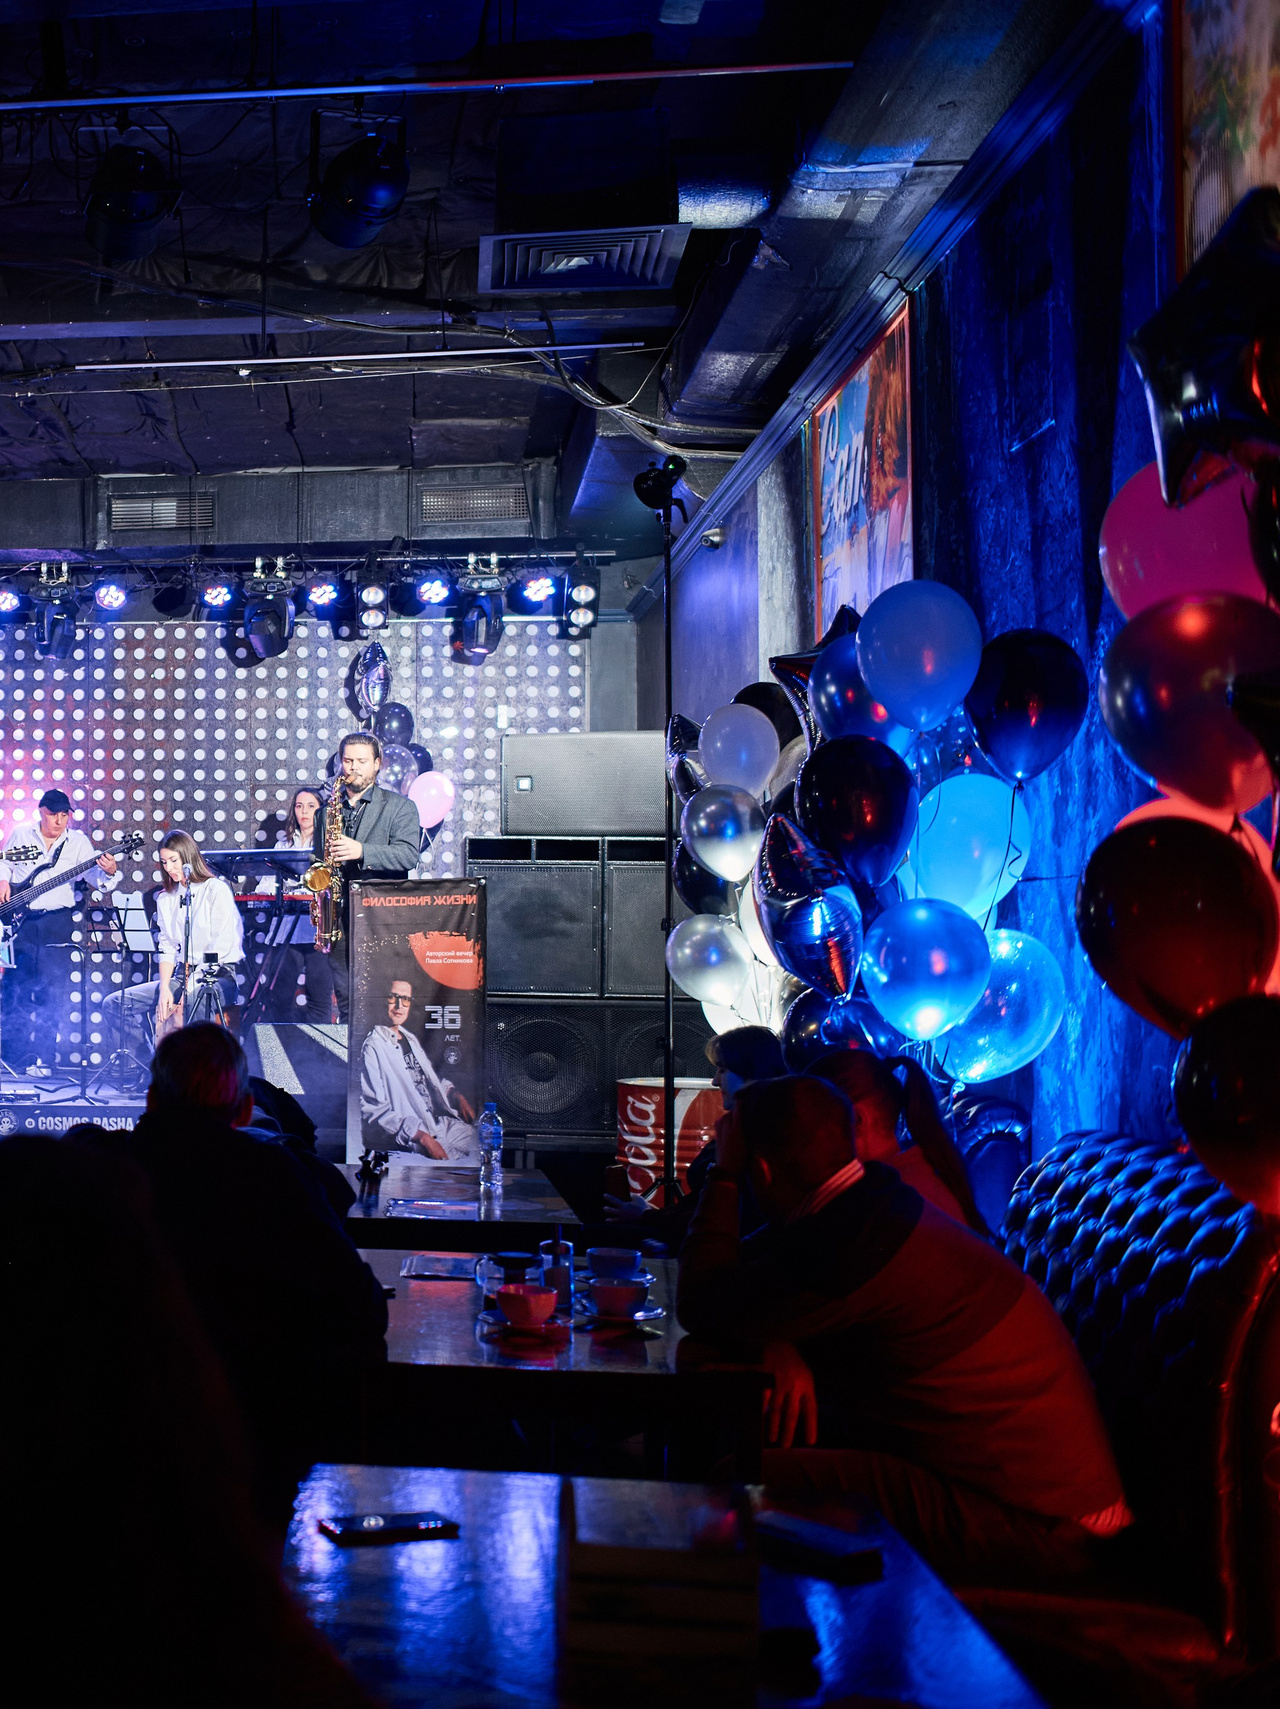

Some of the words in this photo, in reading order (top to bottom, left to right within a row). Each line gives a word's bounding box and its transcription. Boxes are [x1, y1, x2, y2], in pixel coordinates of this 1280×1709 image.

[362, 895, 432, 907] ФИЛОСОФИЯ
[433, 894, 477, 906] ЖИЗНИ
[425, 950, 456, 958] Авторский
[424, 1005, 461, 1029] 36
[444, 1034, 461, 1042] ЛЕТ.
[92, 1117, 135, 1132] PASHA
